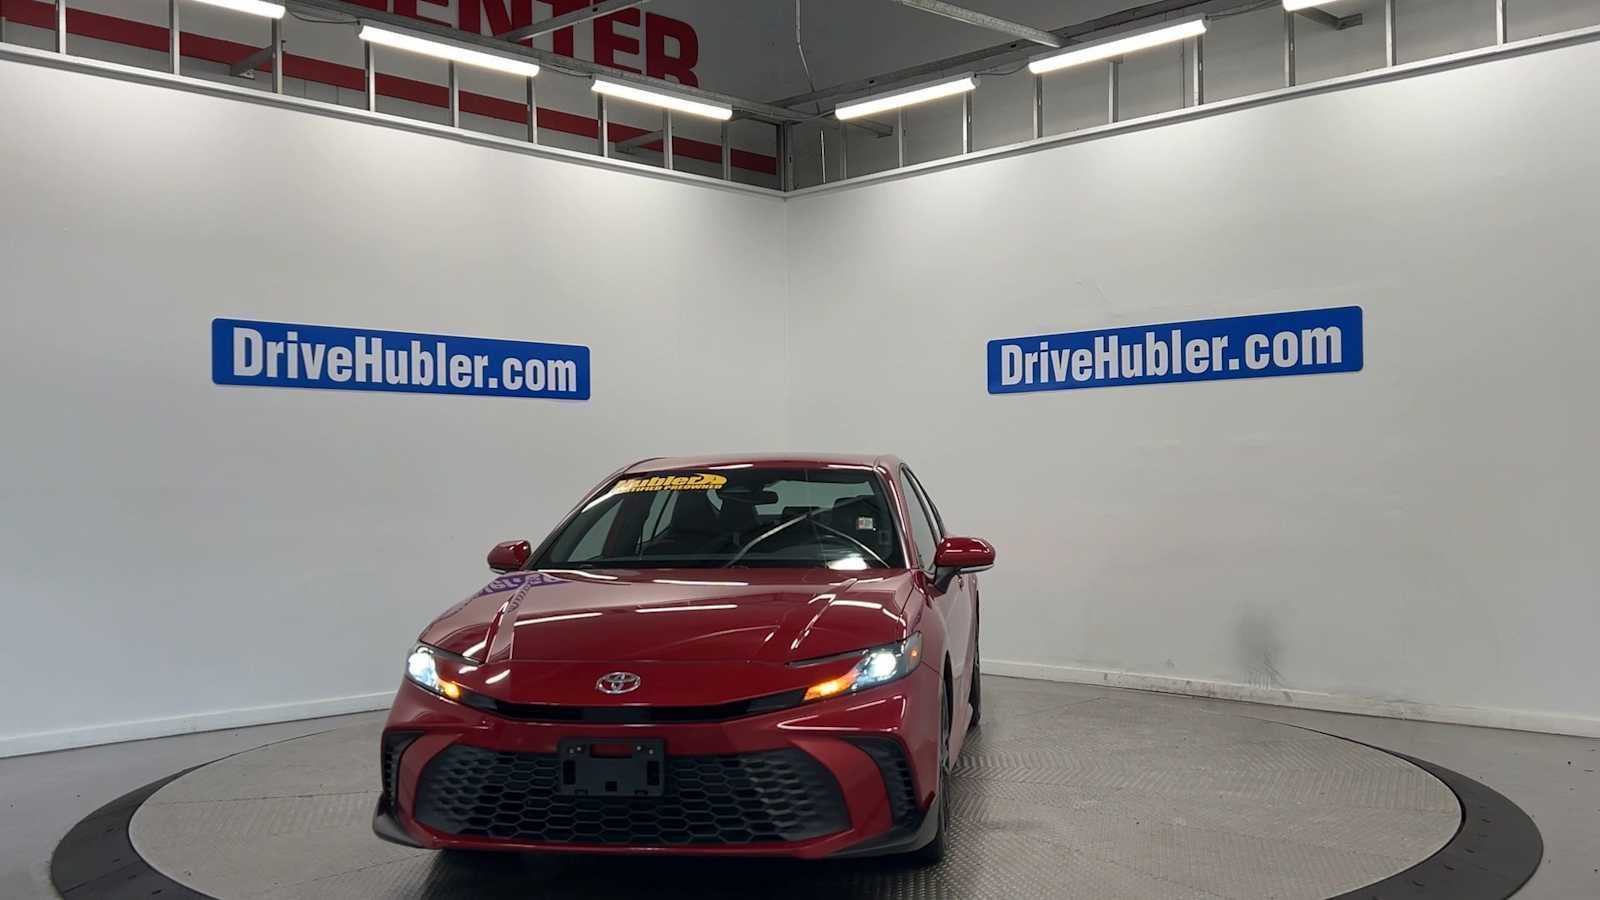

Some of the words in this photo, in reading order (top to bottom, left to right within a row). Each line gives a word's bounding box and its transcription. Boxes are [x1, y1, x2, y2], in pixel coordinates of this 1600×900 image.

[343, 0, 699, 89] ENTER
[232, 326, 577, 392] DriveHubler.com
[1000, 325, 1342, 386] DriveHubler.com
